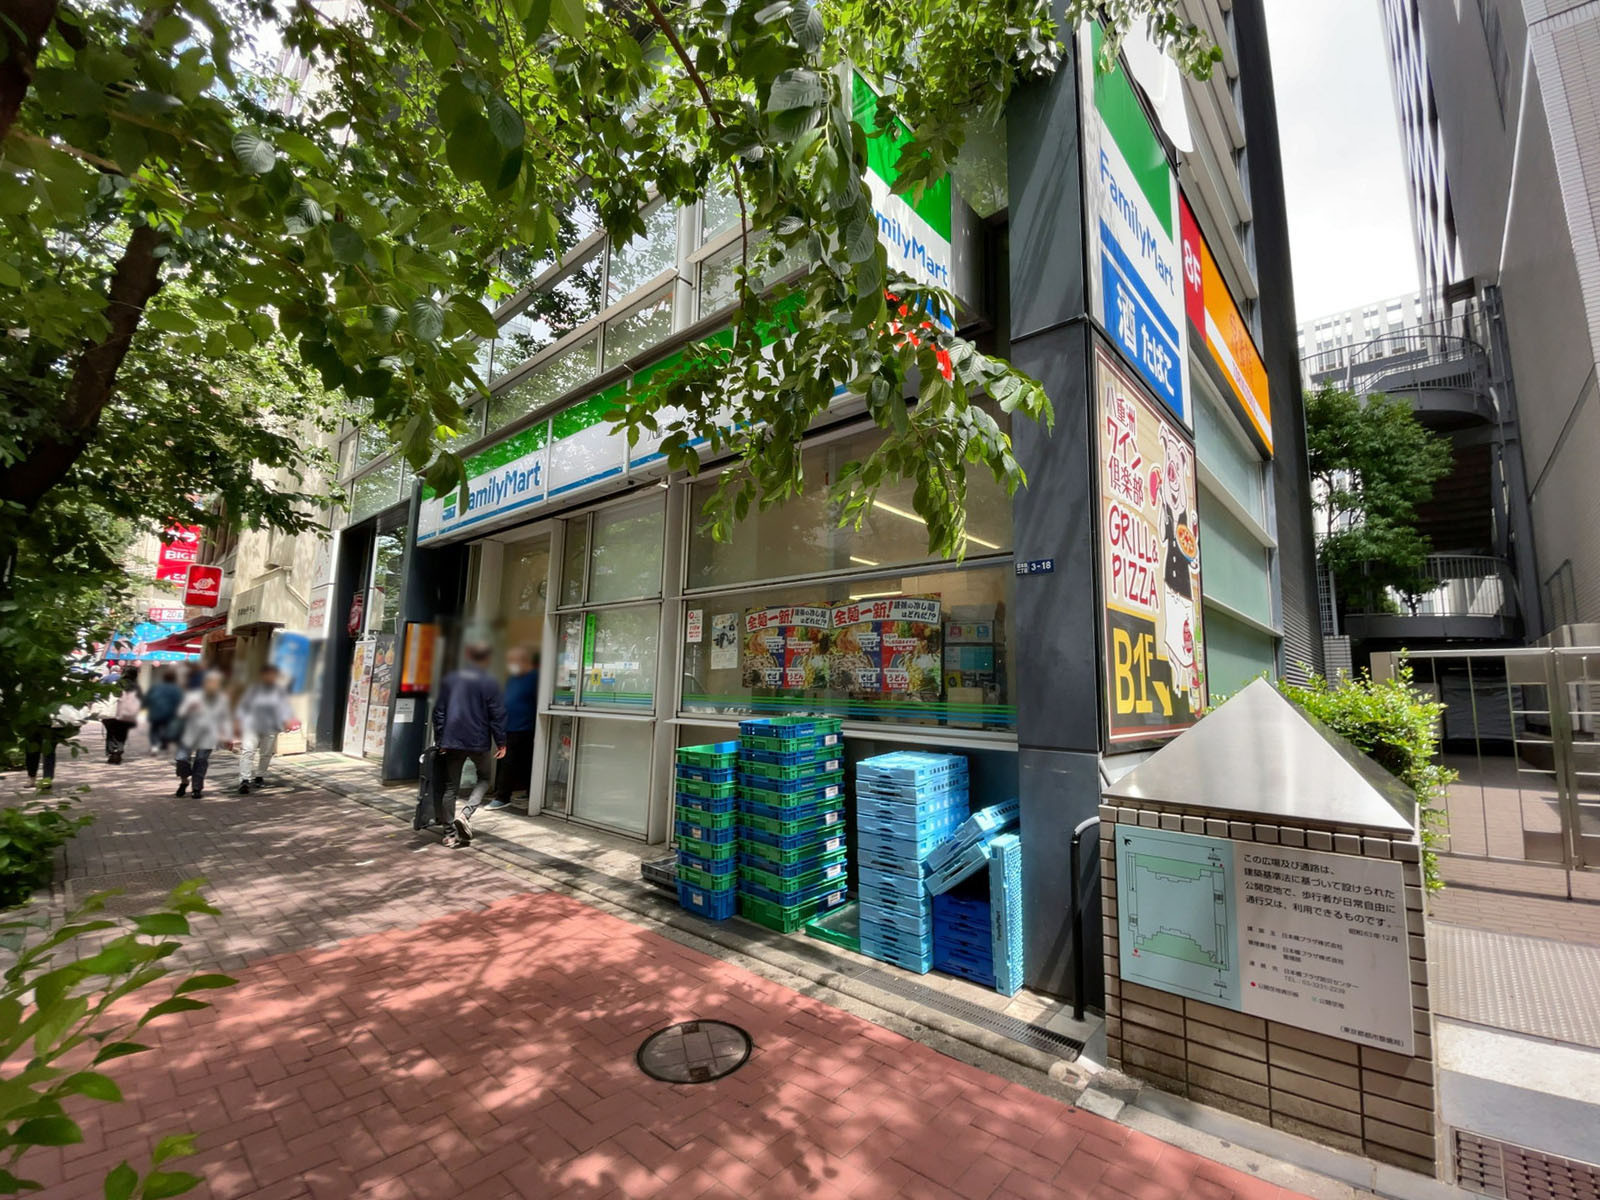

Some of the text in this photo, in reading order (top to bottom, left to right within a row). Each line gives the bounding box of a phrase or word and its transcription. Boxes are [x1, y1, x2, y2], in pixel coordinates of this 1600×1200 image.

[871, 209, 948, 287] milyMart
[1100, 147, 1174, 297] FamilyMart
[1184, 239, 1201, 293] 8F
[1117, 282, 1175, 397] 酒 たばこ
[1107, 416, 1142, 470] ワイン
[467, 460, 541, 510] amilyMart
[165, 550, 190, 560] BIG
[1112, 552, 1159, 609] PIZZA
[1112, 626, 1153, 715] B1F
[1244, 854, 1336, 875] この広場及び通路は、
[1244, 867, 1396, 899] 建築基準法に基づいて設けられた
[1245, 881, 1397, 914] 公開空地で、歩行者が日常自由に
[1246, 895, 1392, 929] 通行又は、利用できるものです。
